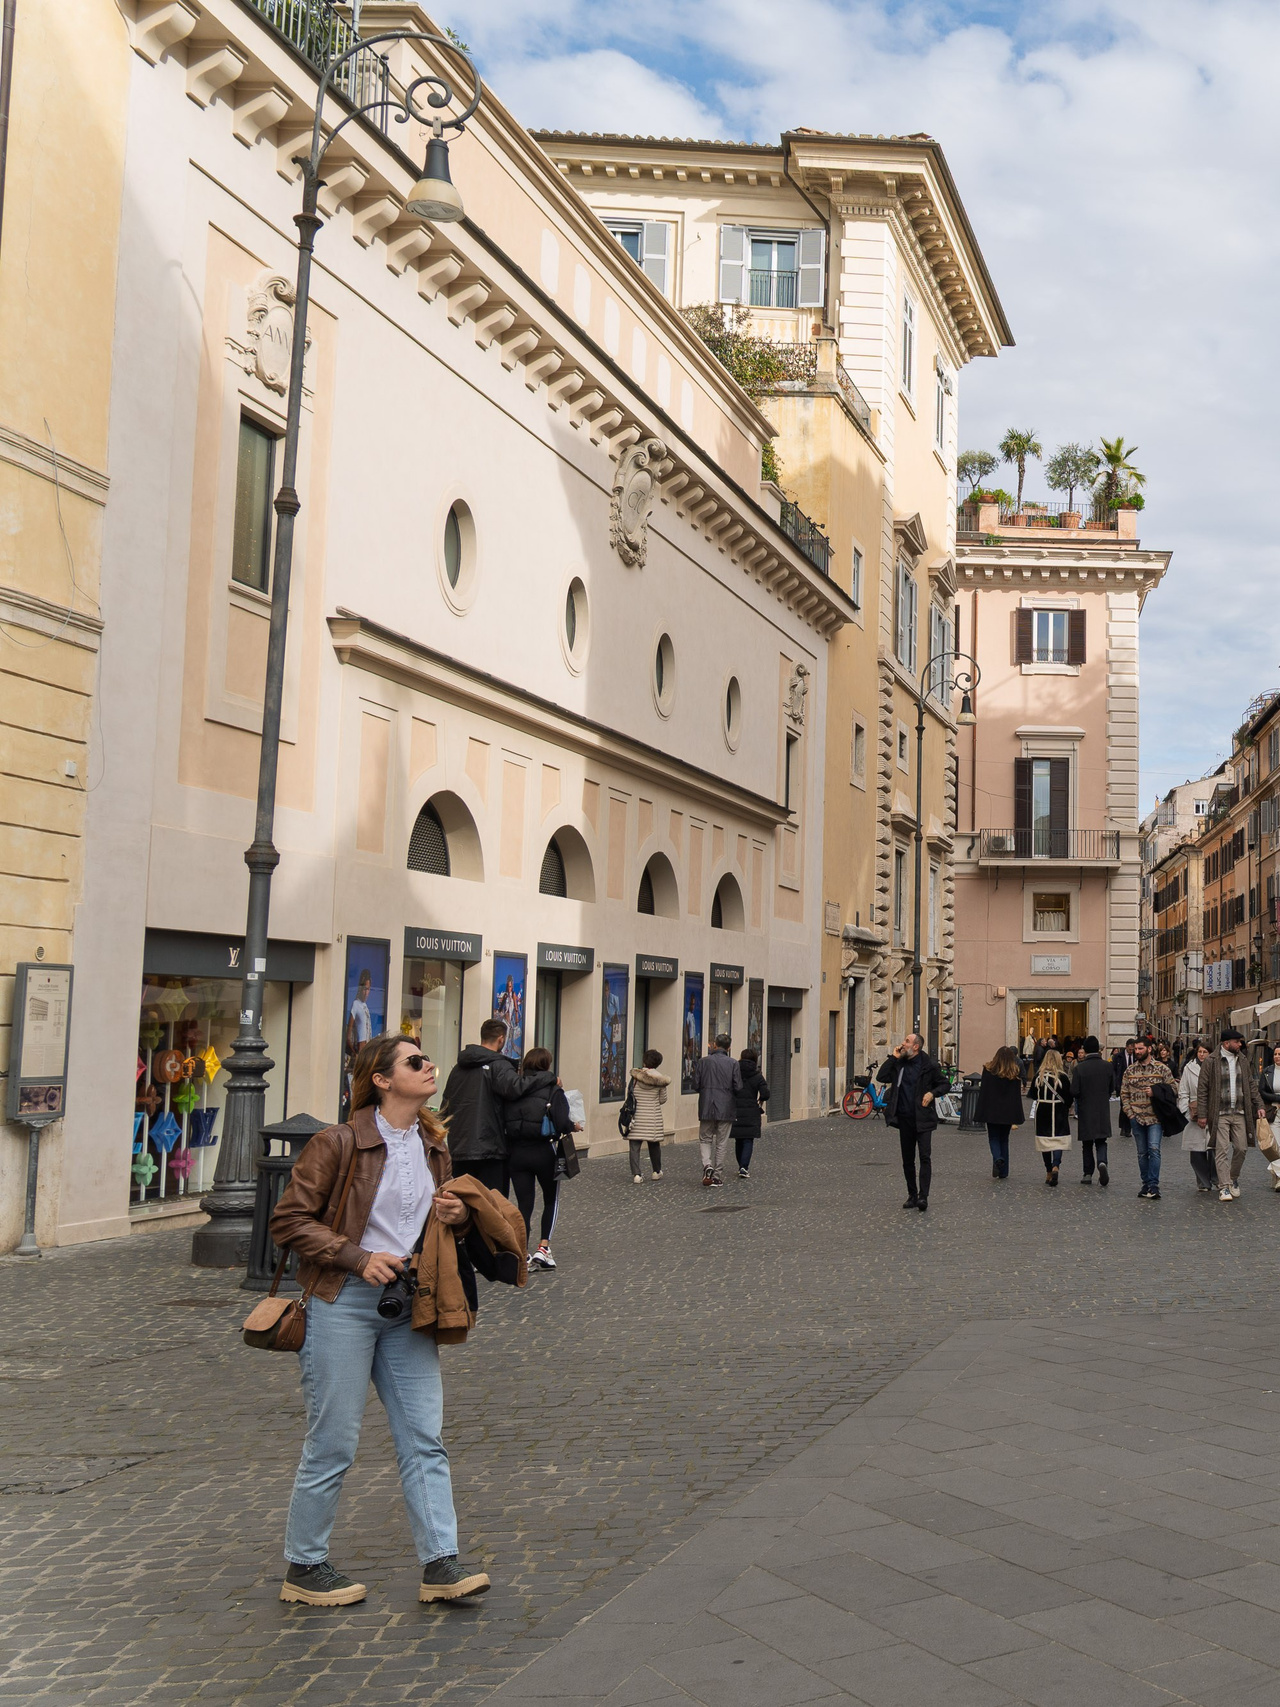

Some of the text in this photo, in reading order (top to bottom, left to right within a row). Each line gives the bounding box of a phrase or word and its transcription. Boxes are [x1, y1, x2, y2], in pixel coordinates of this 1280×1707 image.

[416, 936, 472, 953] LOUIS VUITTON
[545, 950, 587, 964] LOUIS VUITTON
[641, 960, 674, 973] LOUIS VUITTON
